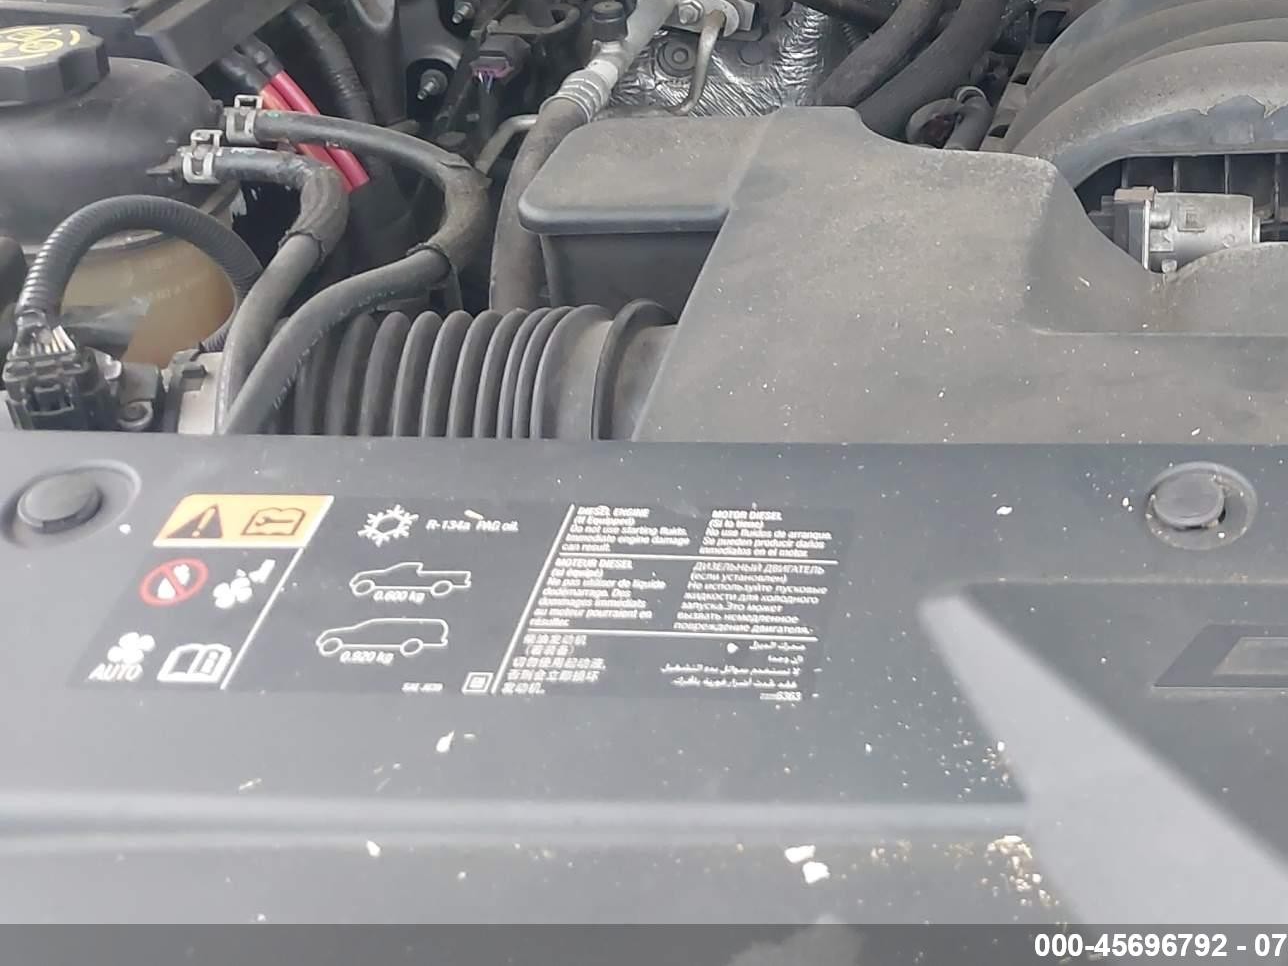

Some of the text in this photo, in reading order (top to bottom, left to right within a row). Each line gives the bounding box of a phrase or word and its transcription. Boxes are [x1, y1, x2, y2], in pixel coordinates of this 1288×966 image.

[612, 507, 650, 518] ENGINE
[712, 510, 747, 519] MOTOR
[425, 519, 471, 531] R-134a
[584, 525, 601, 533] not
[651, 536, 690, 546] damage
[555, 558, 633, 569] MOTEUR DIESEL
[763, 563, 825, 575] ДВИГАТЕЛЬ
[408, 591, 425, 603] kg
[376, 652, 394, 665] kg
[88, 663, 143, 681] AUTO
